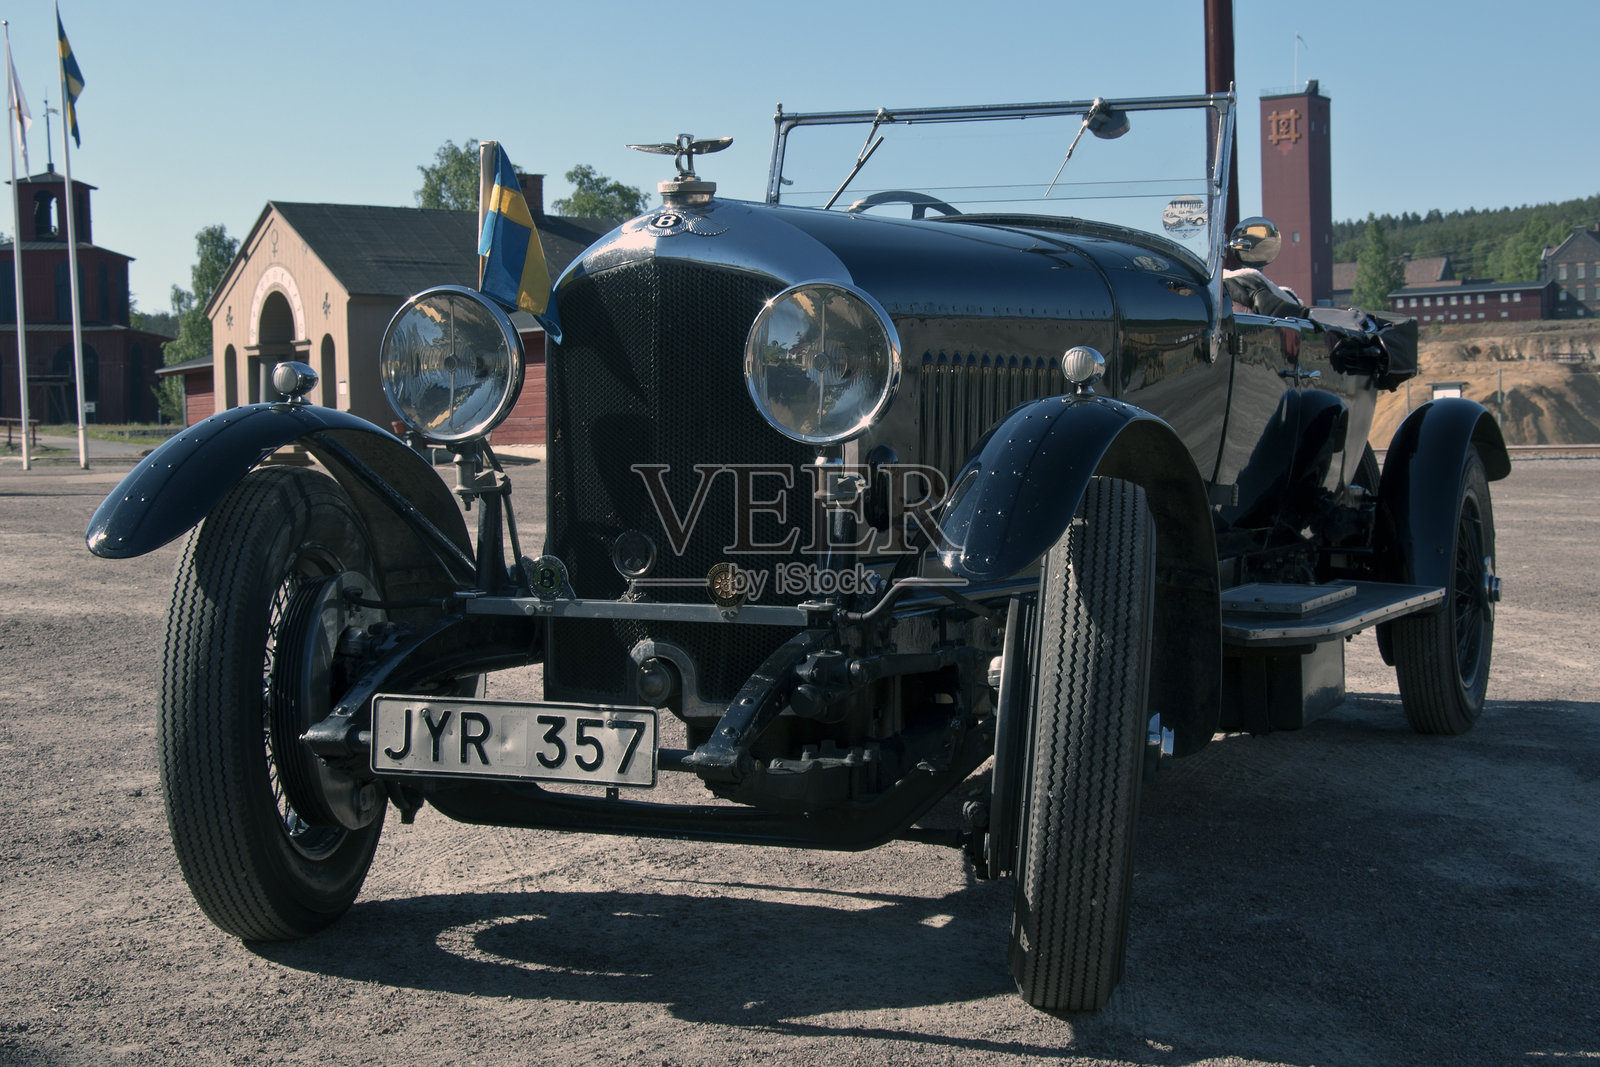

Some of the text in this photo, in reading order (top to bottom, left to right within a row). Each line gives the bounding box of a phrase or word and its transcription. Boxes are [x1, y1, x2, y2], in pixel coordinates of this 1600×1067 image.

[656, 214, 677, 228] B
[540, 568, 556, 588] B
[384, 709, 646, 774] JYR 357
